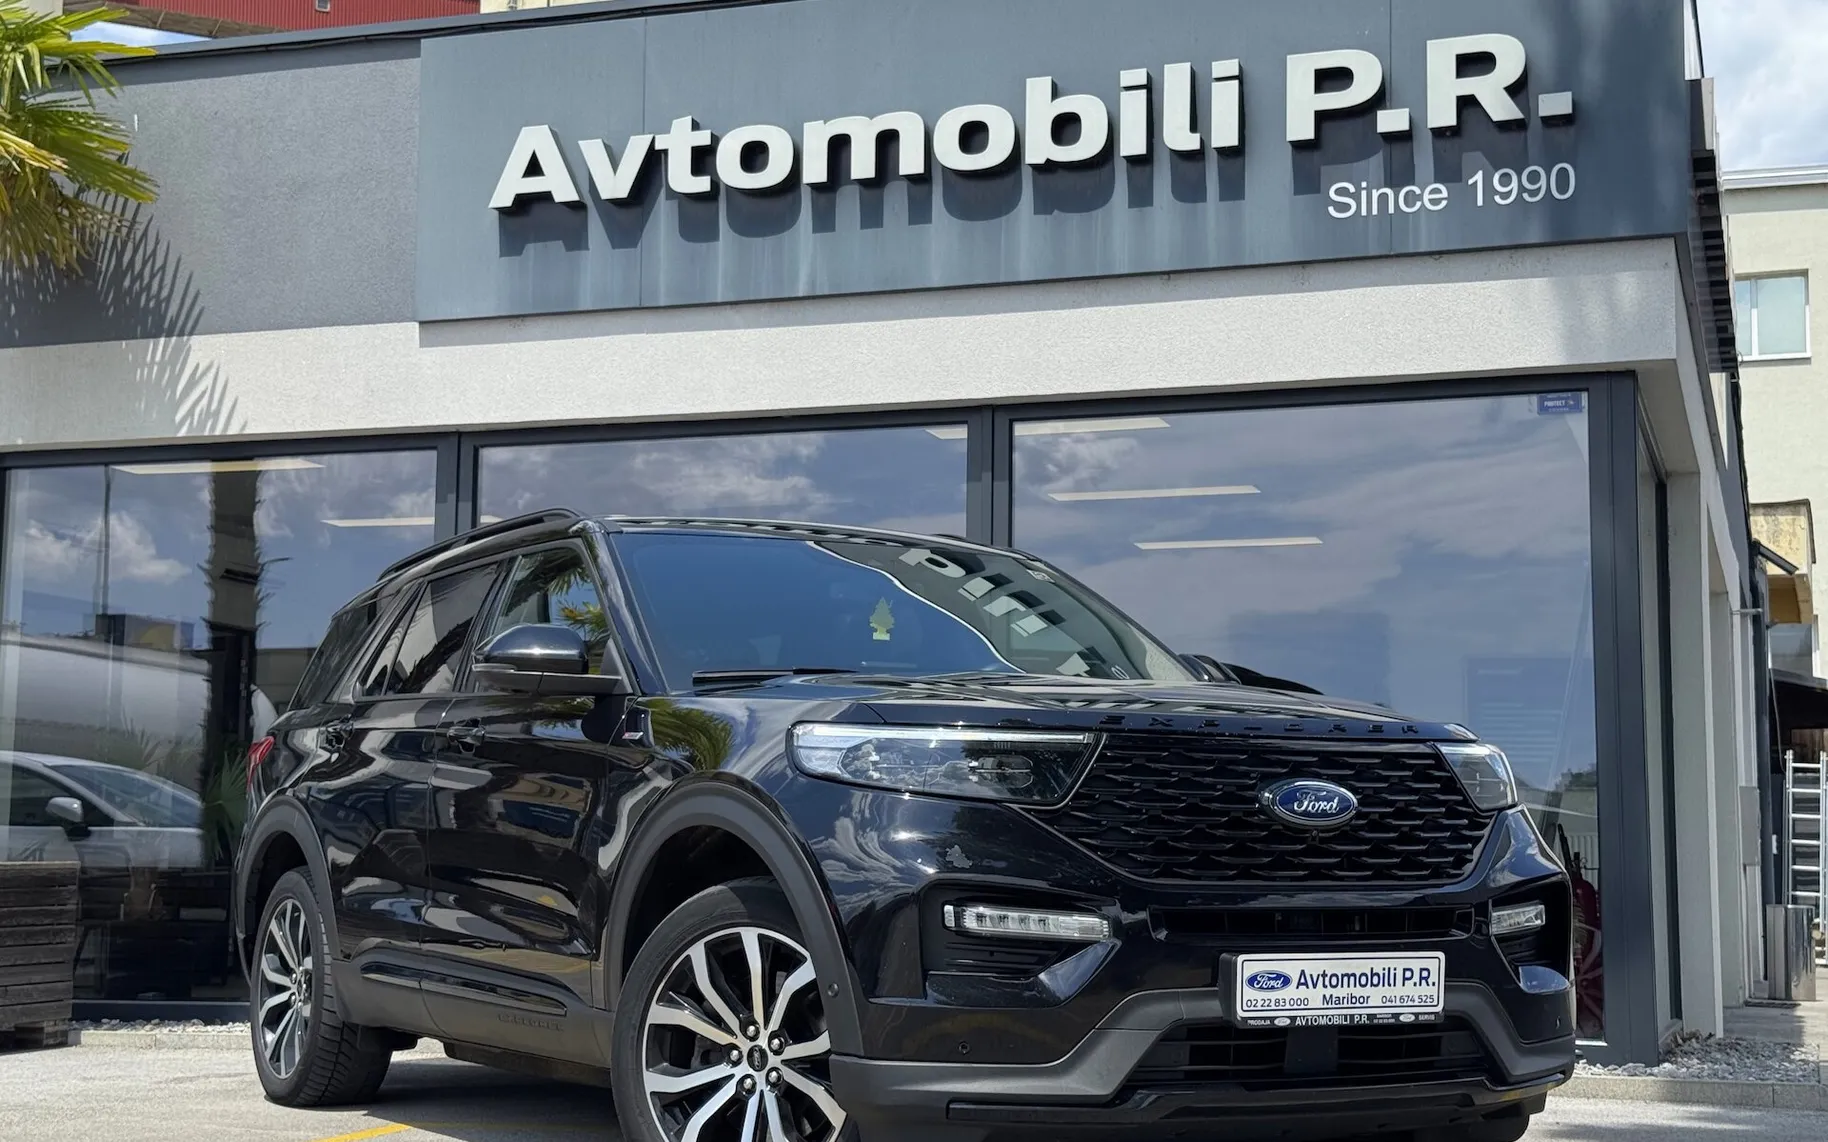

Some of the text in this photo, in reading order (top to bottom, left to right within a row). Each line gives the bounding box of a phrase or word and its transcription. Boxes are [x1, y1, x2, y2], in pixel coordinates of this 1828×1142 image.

[488, 33, 1574, 210] Avtomobili P.R.
[1327, 162, 1576, 219] Since 1990
[1293, 789, 1340, 814] Ford
[1253, 966, 1436, 990] Ford Avtomobili P.R.
[1245, 993, 1435, 1008] 02 22 83 000 Maribor 041 674 525
[1295, 1014, 1350, 1026] AVTOMOBILI
[1354, 1014, 1370, 1025] P.R.
